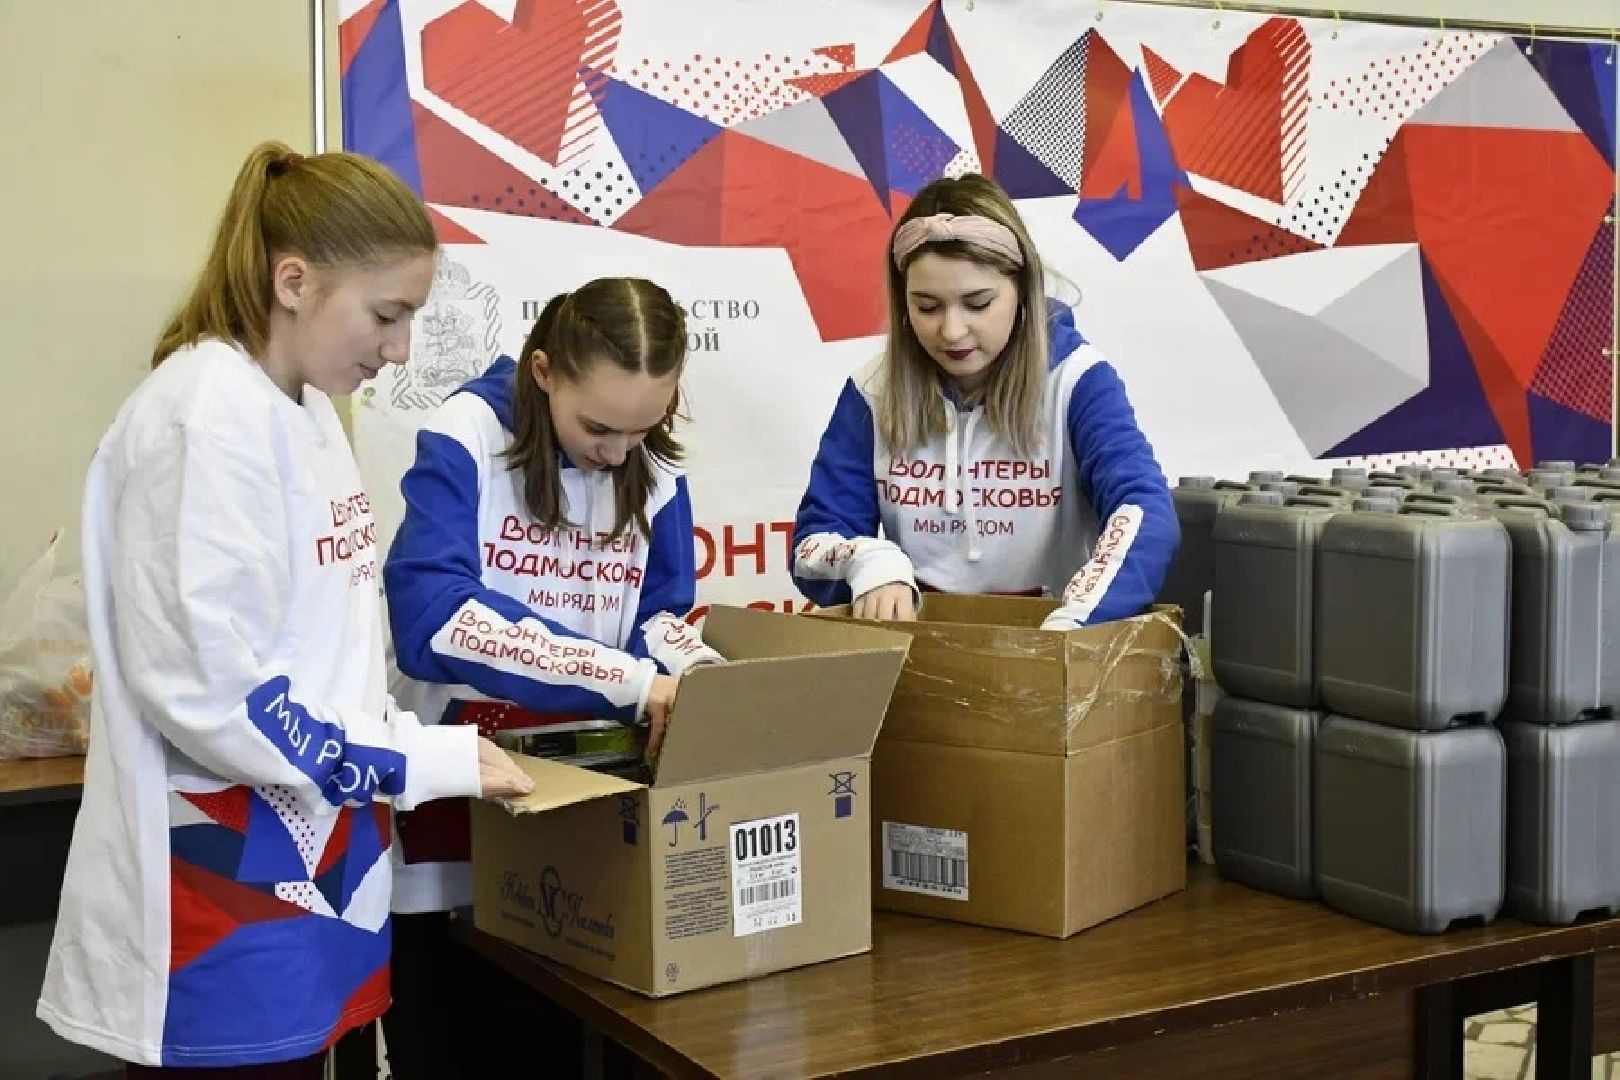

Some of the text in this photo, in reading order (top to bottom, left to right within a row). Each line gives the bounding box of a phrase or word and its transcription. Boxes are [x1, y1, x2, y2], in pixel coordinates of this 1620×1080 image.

[914, 517, 946, 535] МЫ
[528, 588, 560, 609] МЫ
[449, 627, 626, 684] ПОДМОСКОВЬЯ
[263, 692, 313, 757] МЫ
[735, 819, 797, 861] 01013
